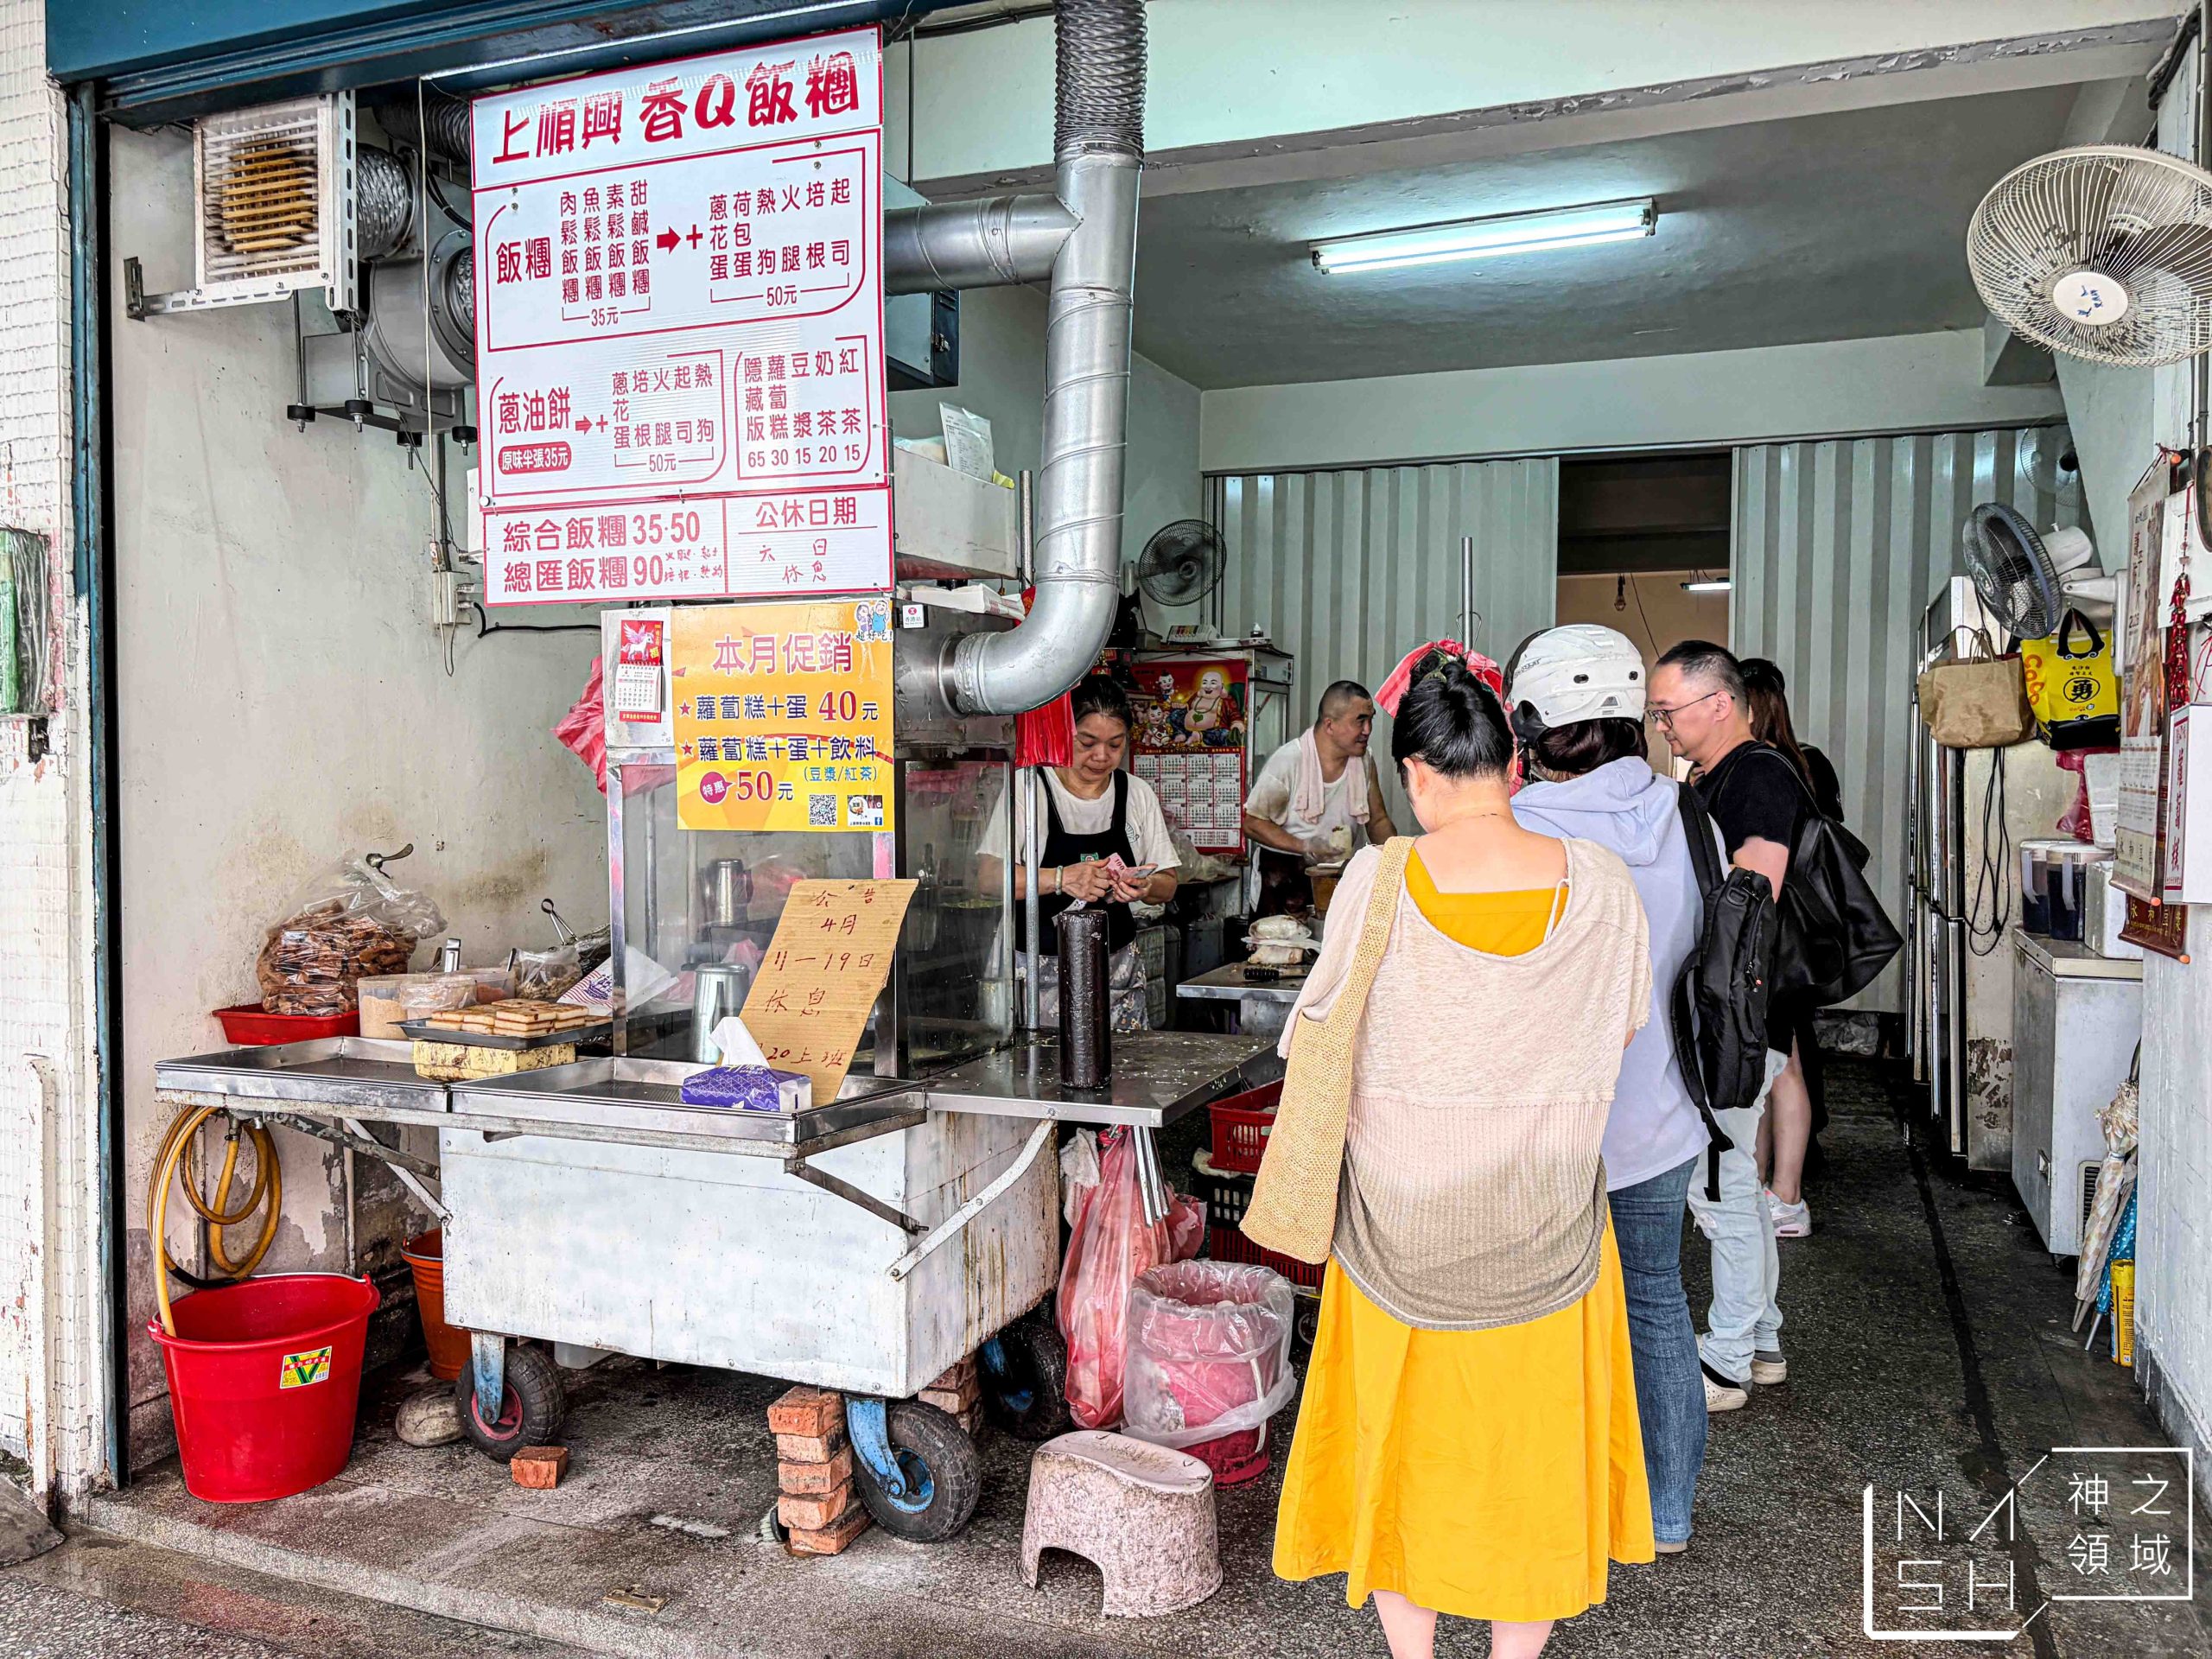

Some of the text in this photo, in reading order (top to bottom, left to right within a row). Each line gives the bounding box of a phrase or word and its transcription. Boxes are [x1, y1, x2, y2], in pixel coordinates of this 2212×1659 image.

[493, 91, 622, 164] 上順興
[561, 191, 579, 304] 肉鬆飯糰
[583, 188, 602, 302] 魚鬆飯糰
[607, 183, 626, 299] 素鬆飯糰
[630, 179, 650, 296] 甜鹹飯糰
[733, 190, 752, 278] 荷包蛋
[757, 188, 776, 276] 熱狗
[781, 184, 800, 273] 火腿
[805, 181, 825, 270] 培根
[830, 178, 850, 266] 起司
[496, 237, 551, 285] 飯糰
[766, 284, 798, 307] 50元
[591, 307, 619, 327] 35元
[632, 370, 652, 448] 培根
[652, 367, 673, 446] 火腿
[674, 365, 692, 444] 起司
[695, 363, 715, 443] 熱狗
[744, 357, 765, 442] 隱藏版
[767, 354, 788, 440] 蘿蔔糕
[791, 352, 812, 438] 豆漿
[816, 350, 836, 436] 奶茶
[839, 348, 861, 435] 紅茶
[502, 446, 569, 471] 原味半張35元
[649, 454, 677, 473] 50元
[748, 444, 861, 467] 65 30 15 20 15
[503, 515, 626, 552] 綜合飯糰
[755, 495, 857, 529] 公休日期
[504, 555, 664, 593] 總匯飯糰 90
[782, 560, 827, 584] 休息
[712, 632, 852, 676] 本月促銷
[818, 690, 879, 721] 40元
[702, 781, 725, 796] 特惠
[737, 771, 793, 801] 50元
[811, 888, 875, 907] 公告
[820, 914, 857, 935] 4月
[765, 987, 825, 1017] 休息
[758, 1043, 847, 1068] 20上班
